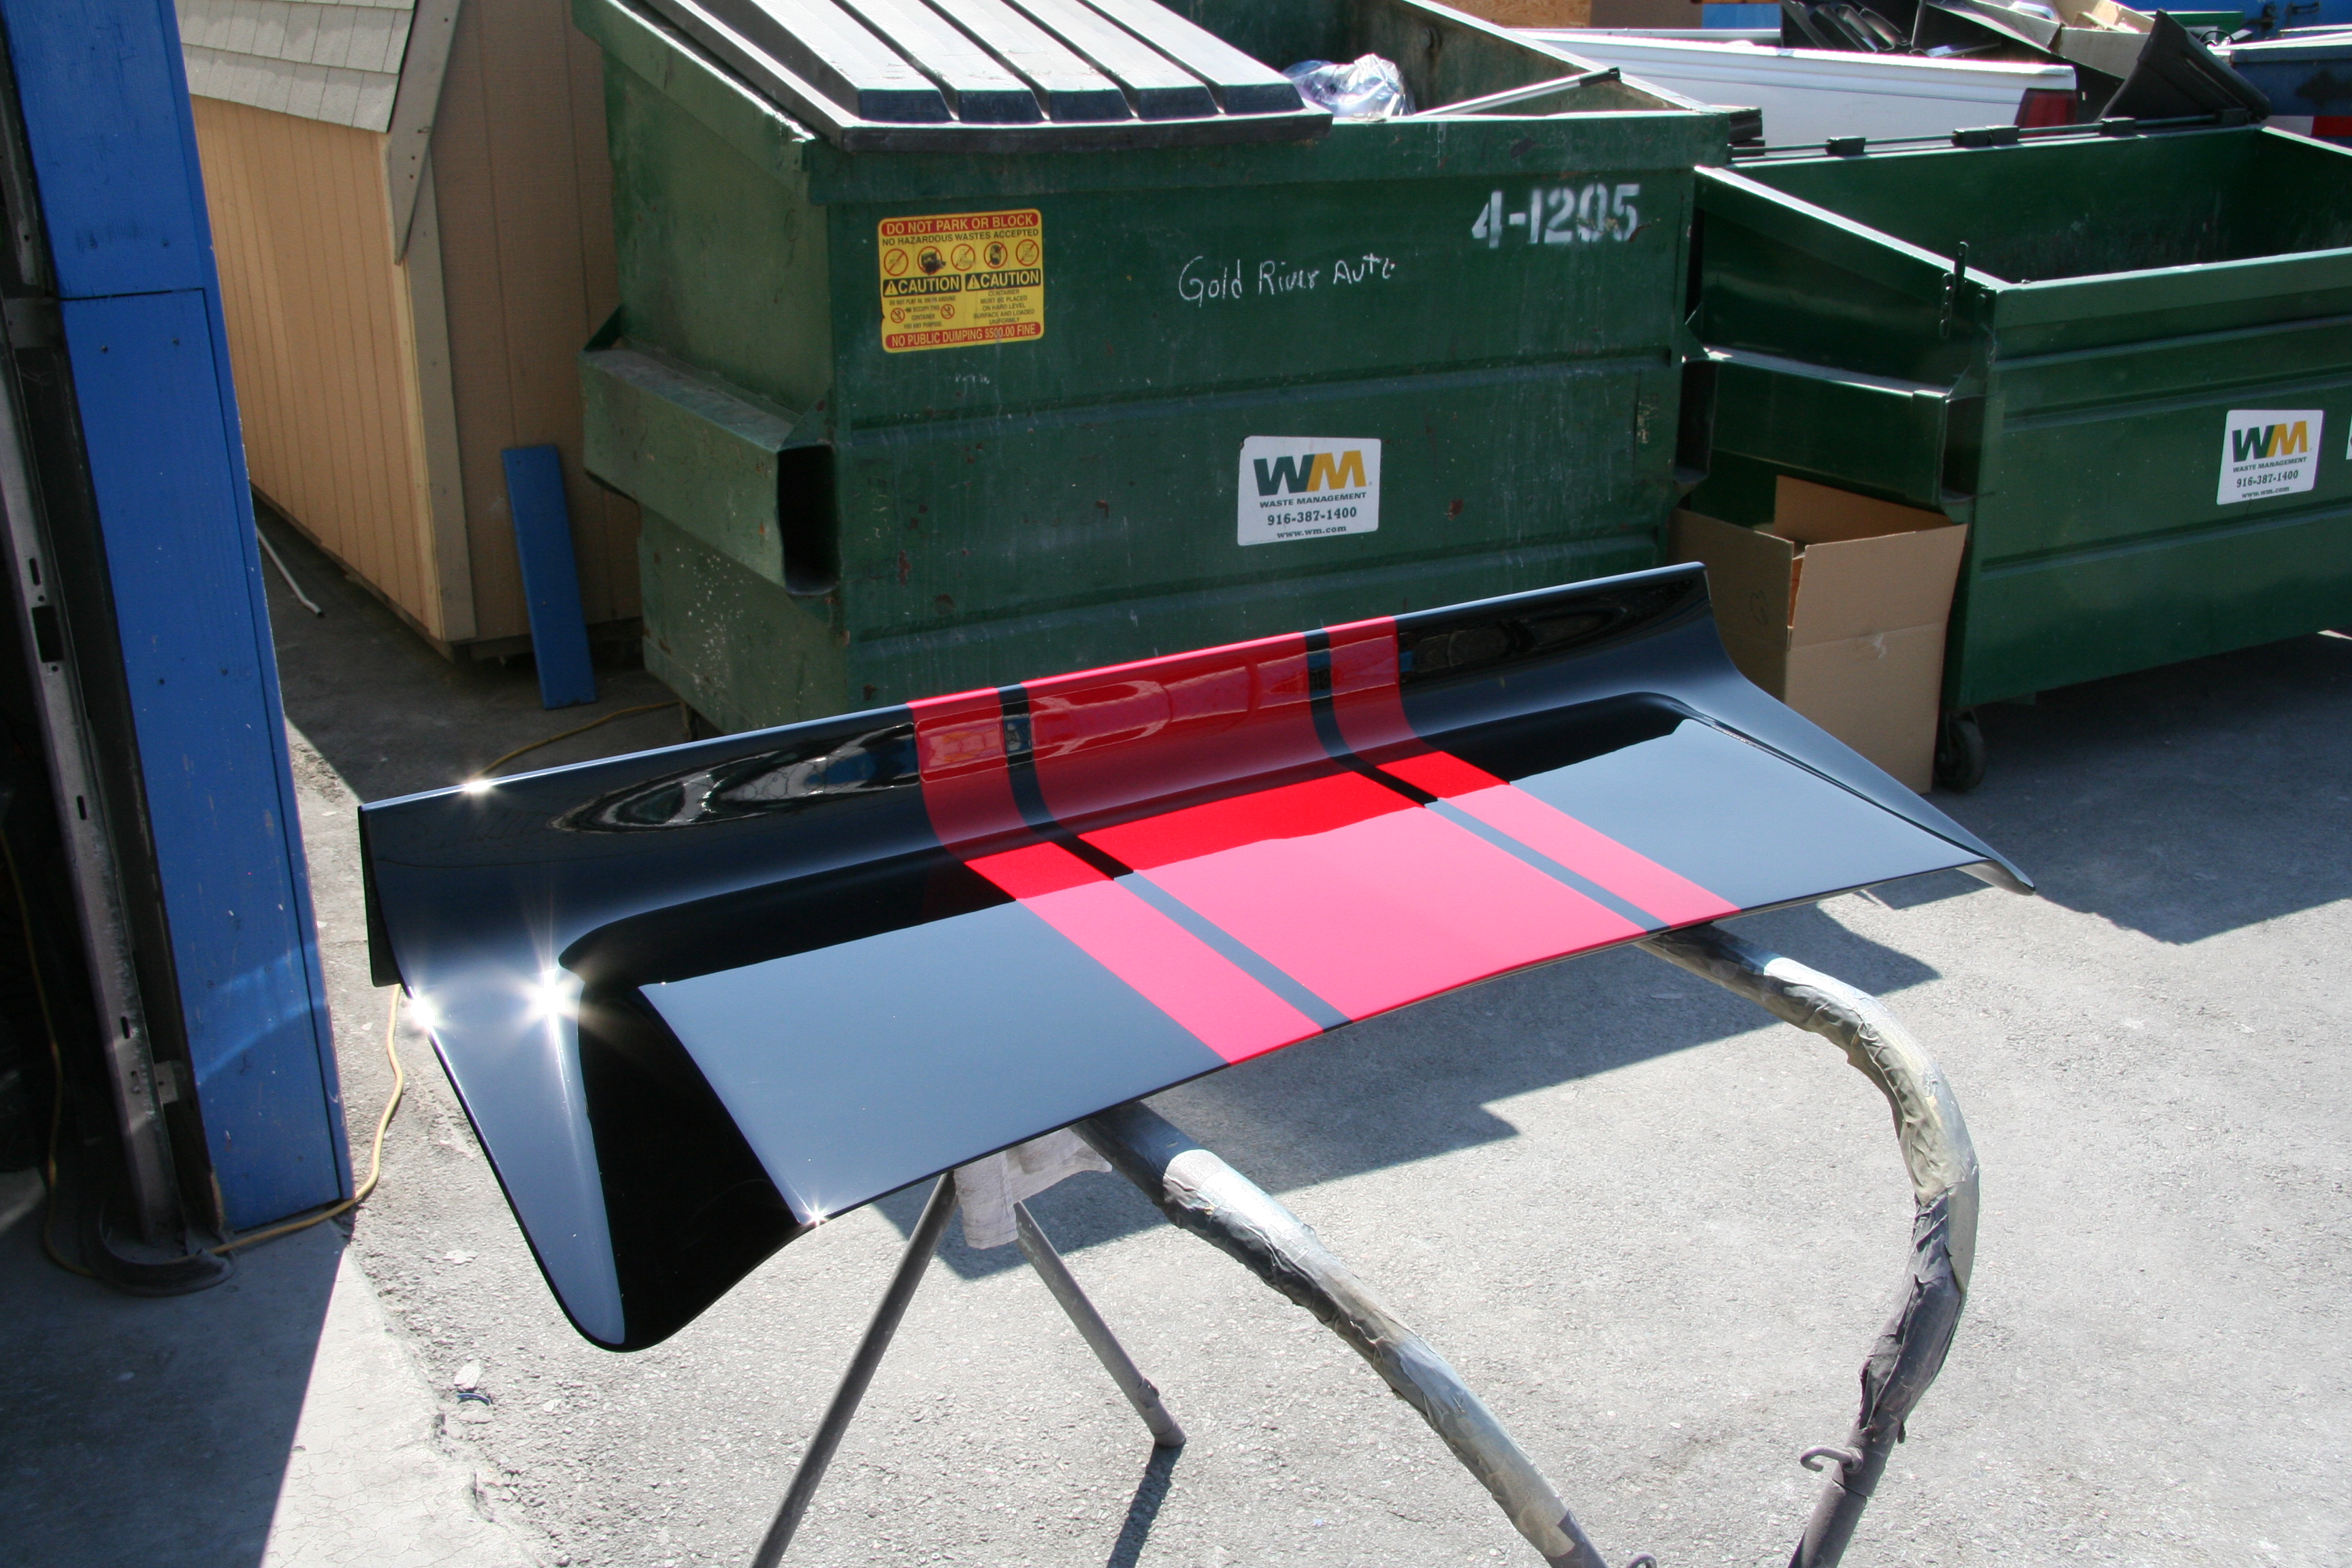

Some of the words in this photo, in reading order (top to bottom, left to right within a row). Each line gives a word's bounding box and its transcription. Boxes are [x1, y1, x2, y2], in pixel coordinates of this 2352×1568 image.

[887, 222, 904, 235] DO
[909, 220, 932, 233] NOT
[936, 218, 968, 231] PARK
[972, 216, 989, 228] OR
[993, 214, 1033, 227] BLOCK
[1471, 183, 1641, 248] 4-1205
[898, 233, 953, 244] HAZARDOUS
[955, 232, 991, 240] WASTES
[994, 229, 1039, 238] ACCEPTED
[898, 276, 960, 293] CAUTION
[980, 270, 1039, 288] CAUTION
[1178, 256, 1243, 308] Gold
[892, 336, 905, 347] NO
[907, 331, 940, 345] PUBLIC
[943, 328, 982, 342] DUMPING
[985, 326, 1014, 339] $500.00
[1017, 324, 1035, 336] FINE
[2232, 421, 2308, 463] WM
[1253, 451, 1367, 496] WM
[2233, 463, 2256, 472] WASTE
[2258, 457, 2307, 468] MANAGEMENT
[2236, 470, 2298, 488] 916-387-1400
[1260, 499, 1294, 508] WASTE
[1296, 492, 1367, 504] MANAGEMENT
[2242, 487, 2289, 498] www.wm.com
[1267, 507, 1357, 525] 916-387-1400
[1277, 525, 1347, 538] www.wm.com
